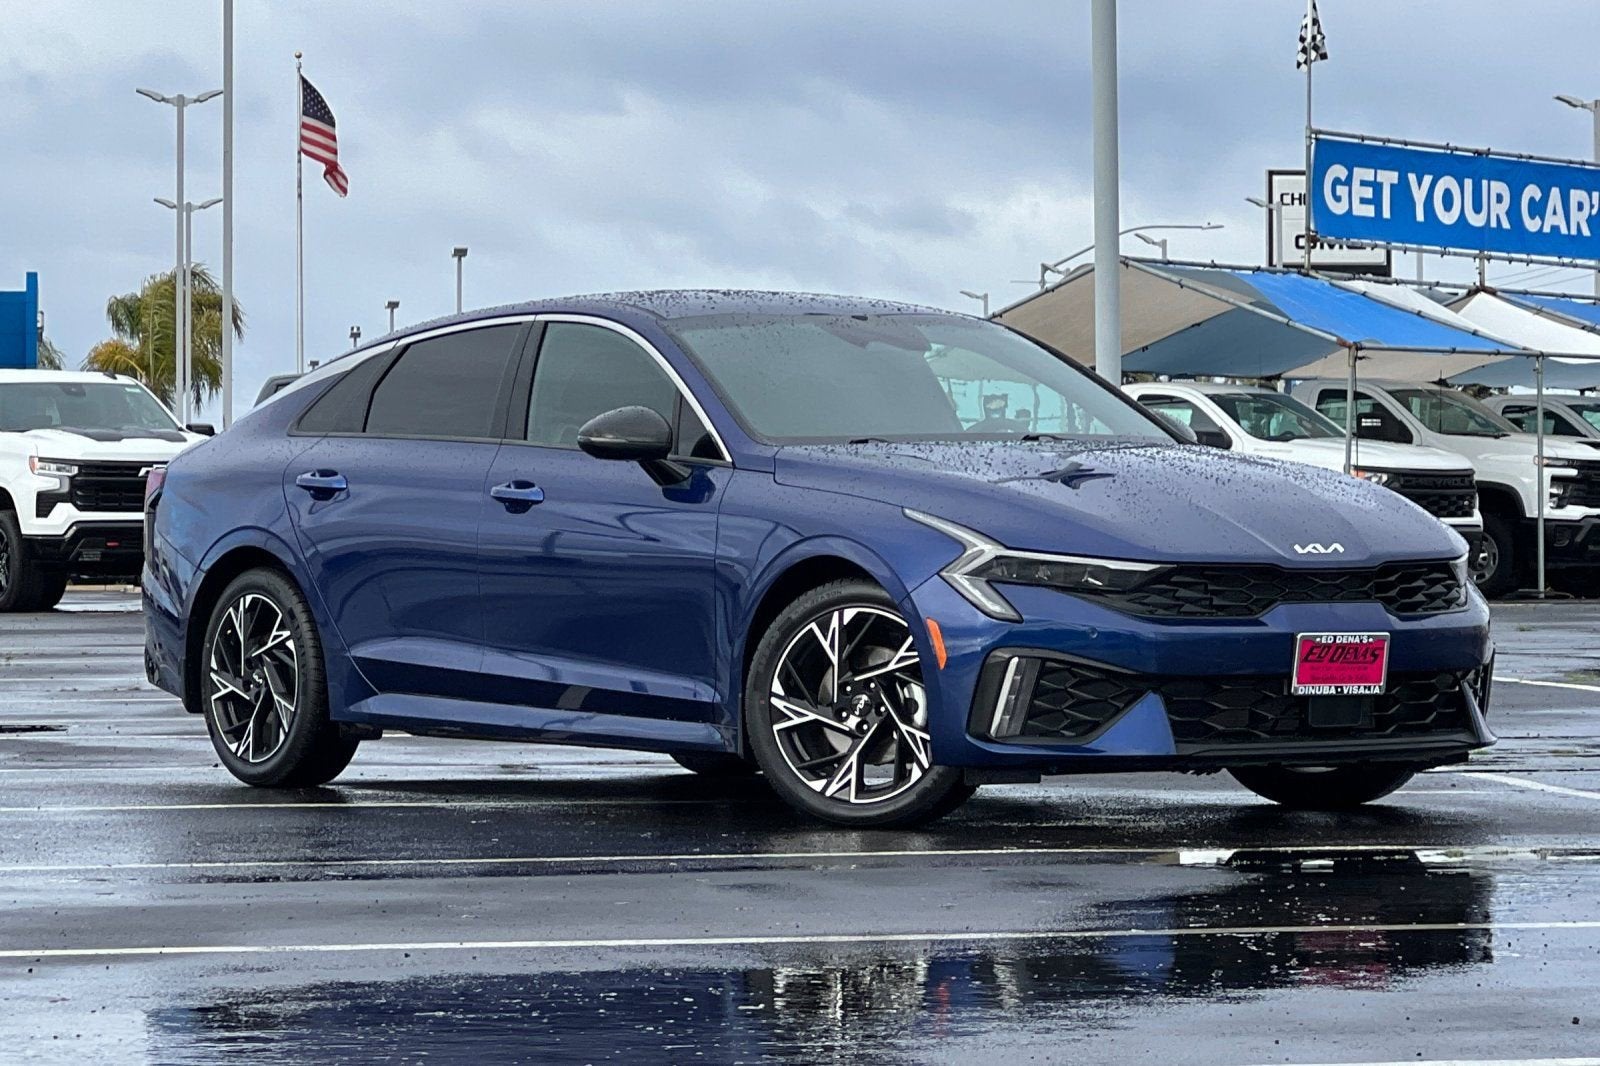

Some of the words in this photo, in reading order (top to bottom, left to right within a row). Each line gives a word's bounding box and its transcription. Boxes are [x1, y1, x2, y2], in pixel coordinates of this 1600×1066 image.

[1323, 164, 1399, 219] GET
[1407, 172, 1511, 230] YOUR
[1321, 635, 1334, 644] ED
[1335, 635, 1368, 644] DENA'S
[1298, 685, 1336, 695] DINUBA
